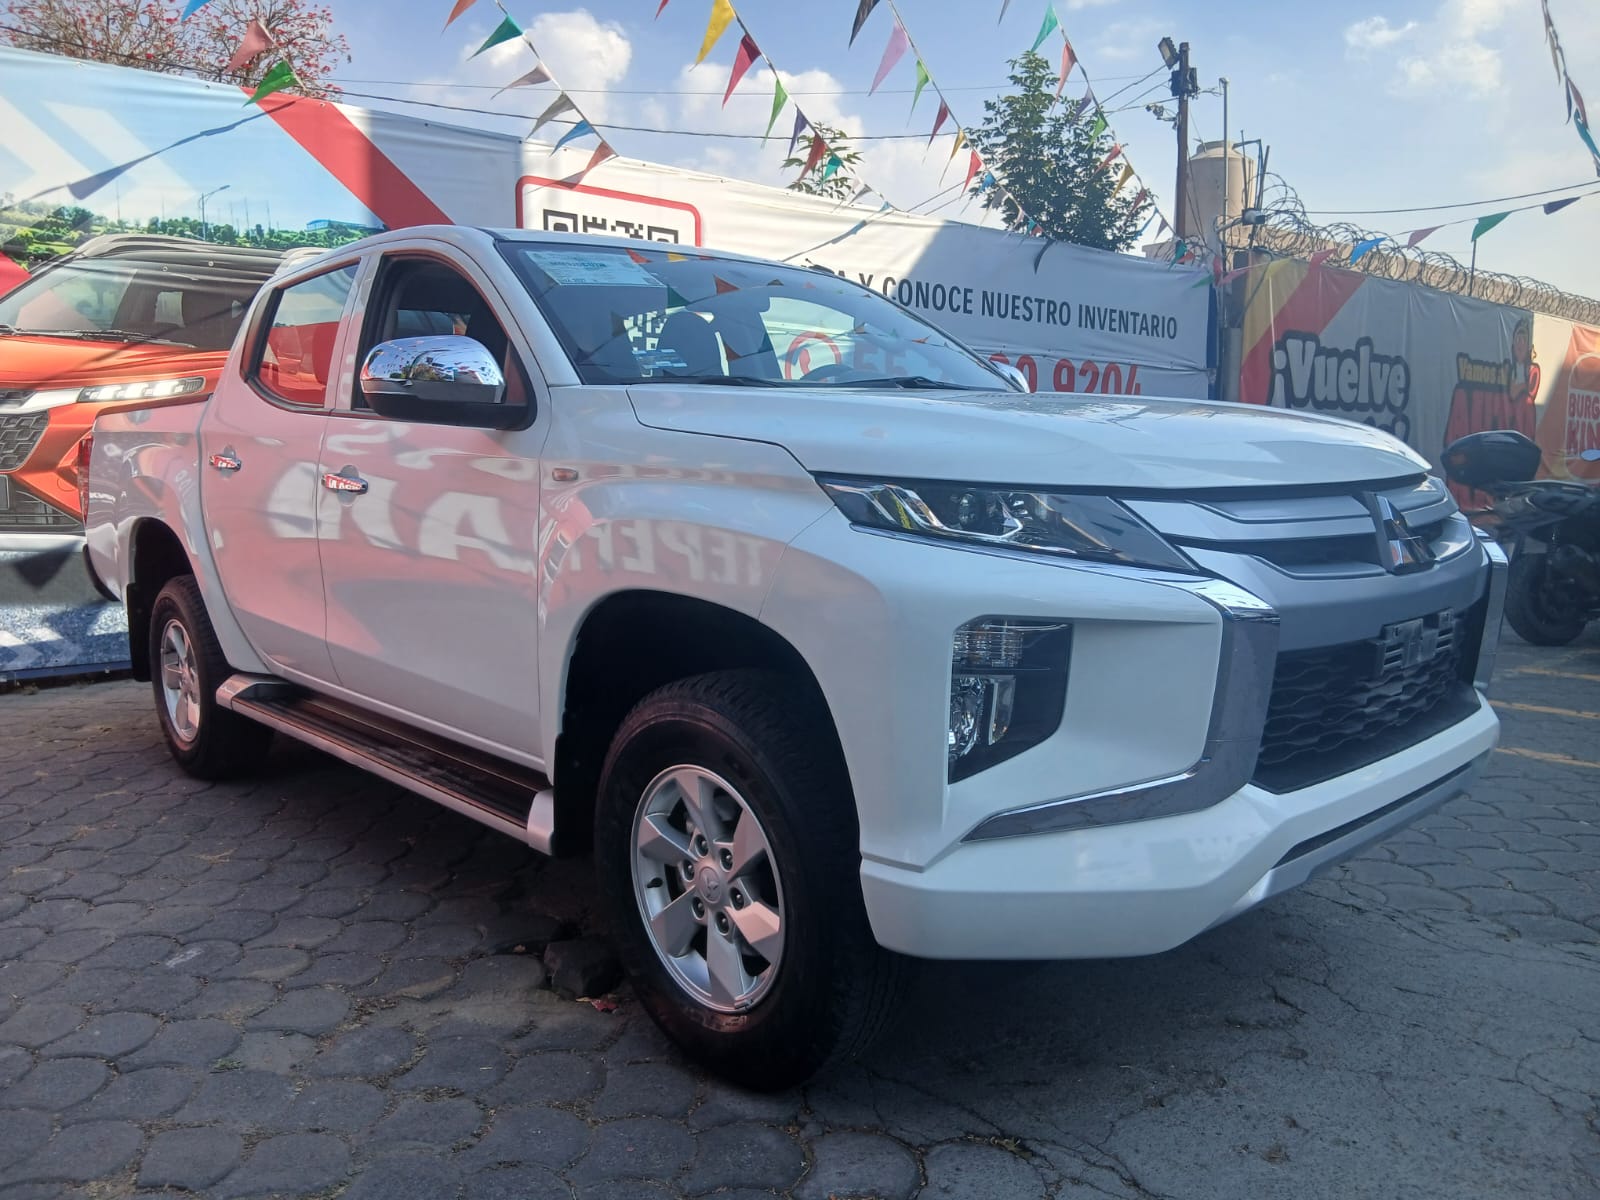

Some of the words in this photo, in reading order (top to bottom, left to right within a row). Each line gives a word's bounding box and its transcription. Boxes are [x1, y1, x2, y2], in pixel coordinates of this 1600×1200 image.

[882, 276, 974, 315] CONOCE
[981, 290, 1071, 326] NUESTRO
[1078, 303, 1178, 340] INVENTARIO
[1053, 358, 1141, 396] 9204
[1271, 338, 1407, 408] ¡Vuelve
